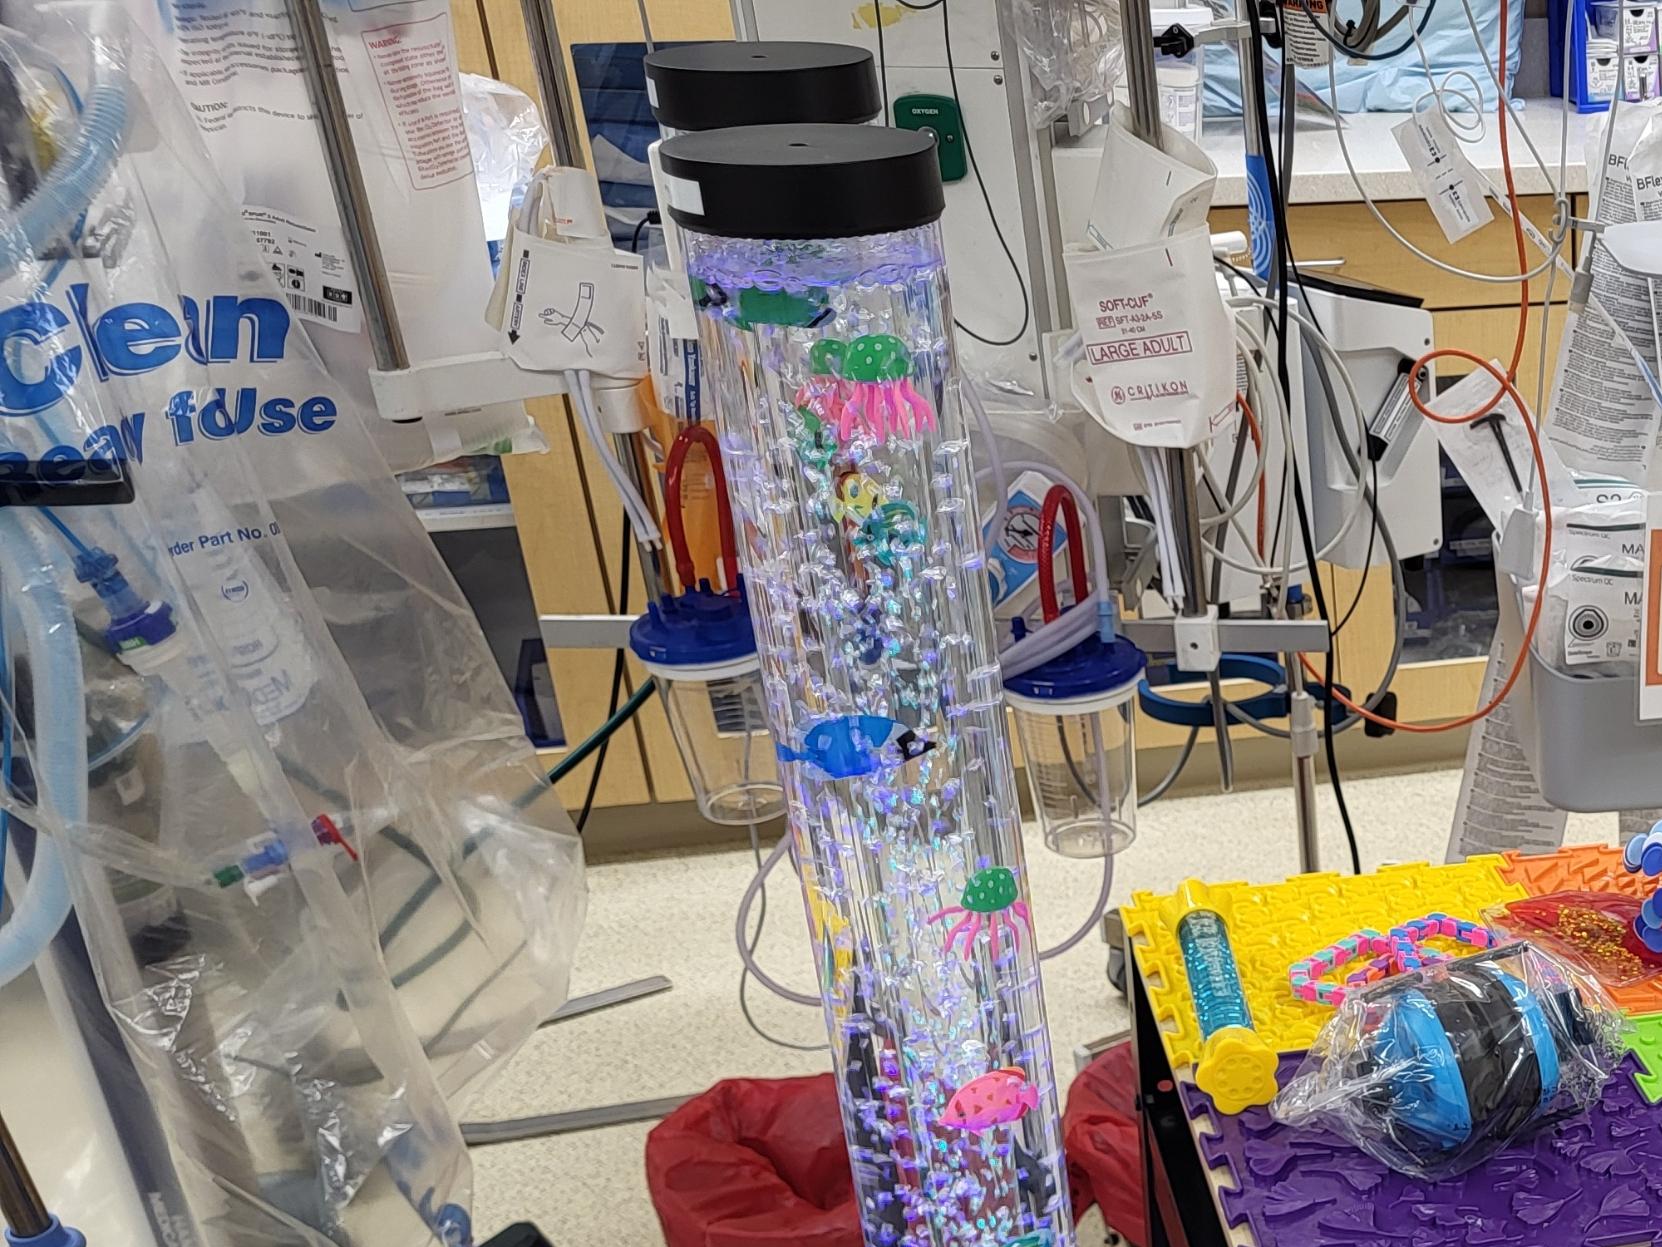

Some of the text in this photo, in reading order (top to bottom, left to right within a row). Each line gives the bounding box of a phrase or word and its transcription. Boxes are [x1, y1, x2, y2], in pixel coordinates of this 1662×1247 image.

[1091, 335, 1185, 363] LARGE ADULT
[1127, 381, 1188, 399] CRITIKON
[198, 530, 232, 550] Part
[1622, 543, 1645, 555] MA
[1572, 574, 1604, 585] Spectrum
[1624, 591, 1643, 605] MA
